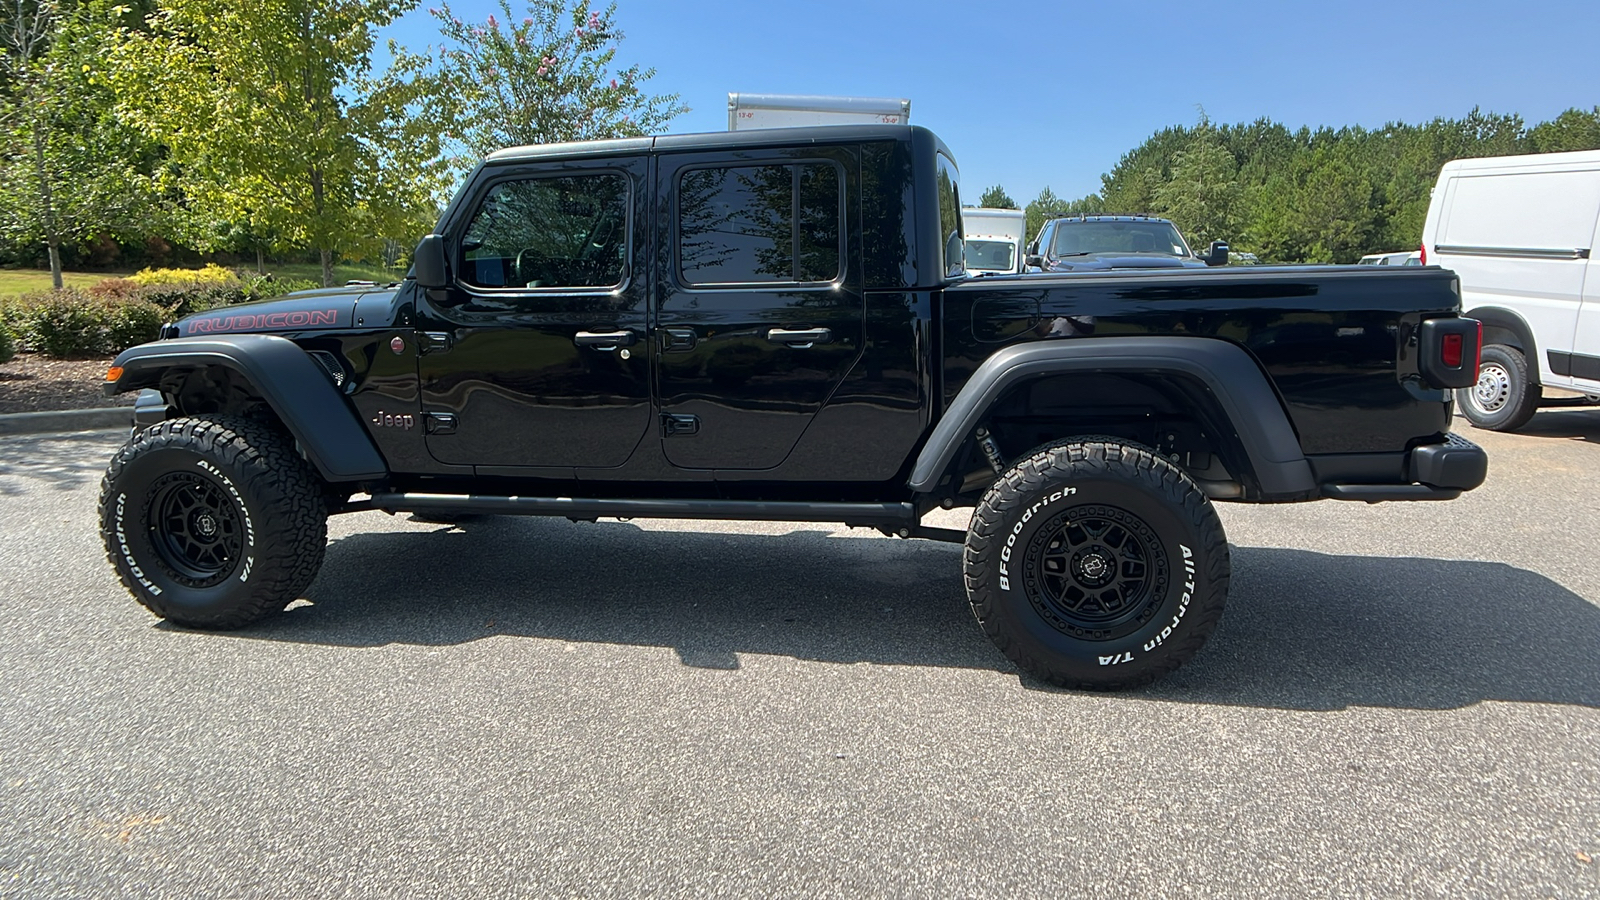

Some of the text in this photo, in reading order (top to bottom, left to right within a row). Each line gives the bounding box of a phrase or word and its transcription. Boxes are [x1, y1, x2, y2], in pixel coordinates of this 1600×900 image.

[188, 309, 337, 334] RUBICON
[372, 410, 414, 431] Jeep
[115, 492, 163, 596] BFGoodrich
[196, 460, 255, 547] All-Terrain
[239, 556, 254, 583] T/A
[999, 486, 1077, 591] BFGoodrich
[1097, 544, 1196, 666] All-Terrain T/A
